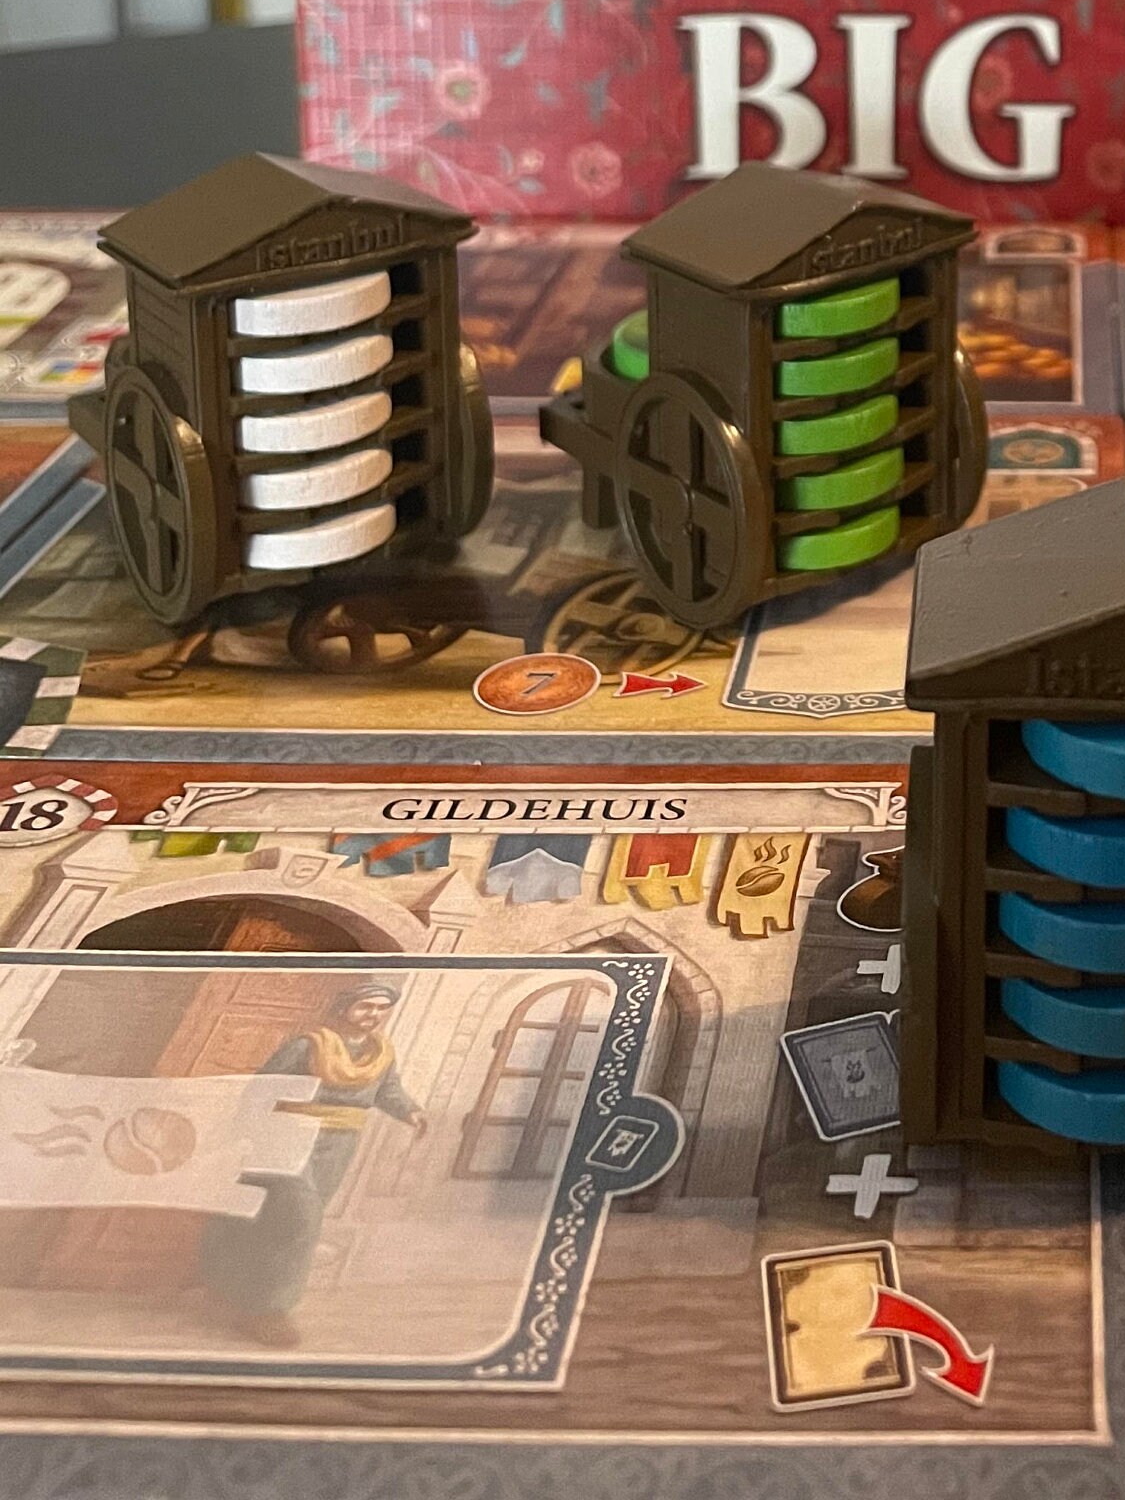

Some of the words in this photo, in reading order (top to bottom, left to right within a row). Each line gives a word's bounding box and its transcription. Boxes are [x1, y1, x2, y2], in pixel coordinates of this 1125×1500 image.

[677, 12, 1076, 182] BIG
[255, 211, 406, 272] Istanbul
[523, 671, 557, 698] 7
[0, 799, 69, 832] 18
[381, 796, 689, 822] GILDEHUIS
